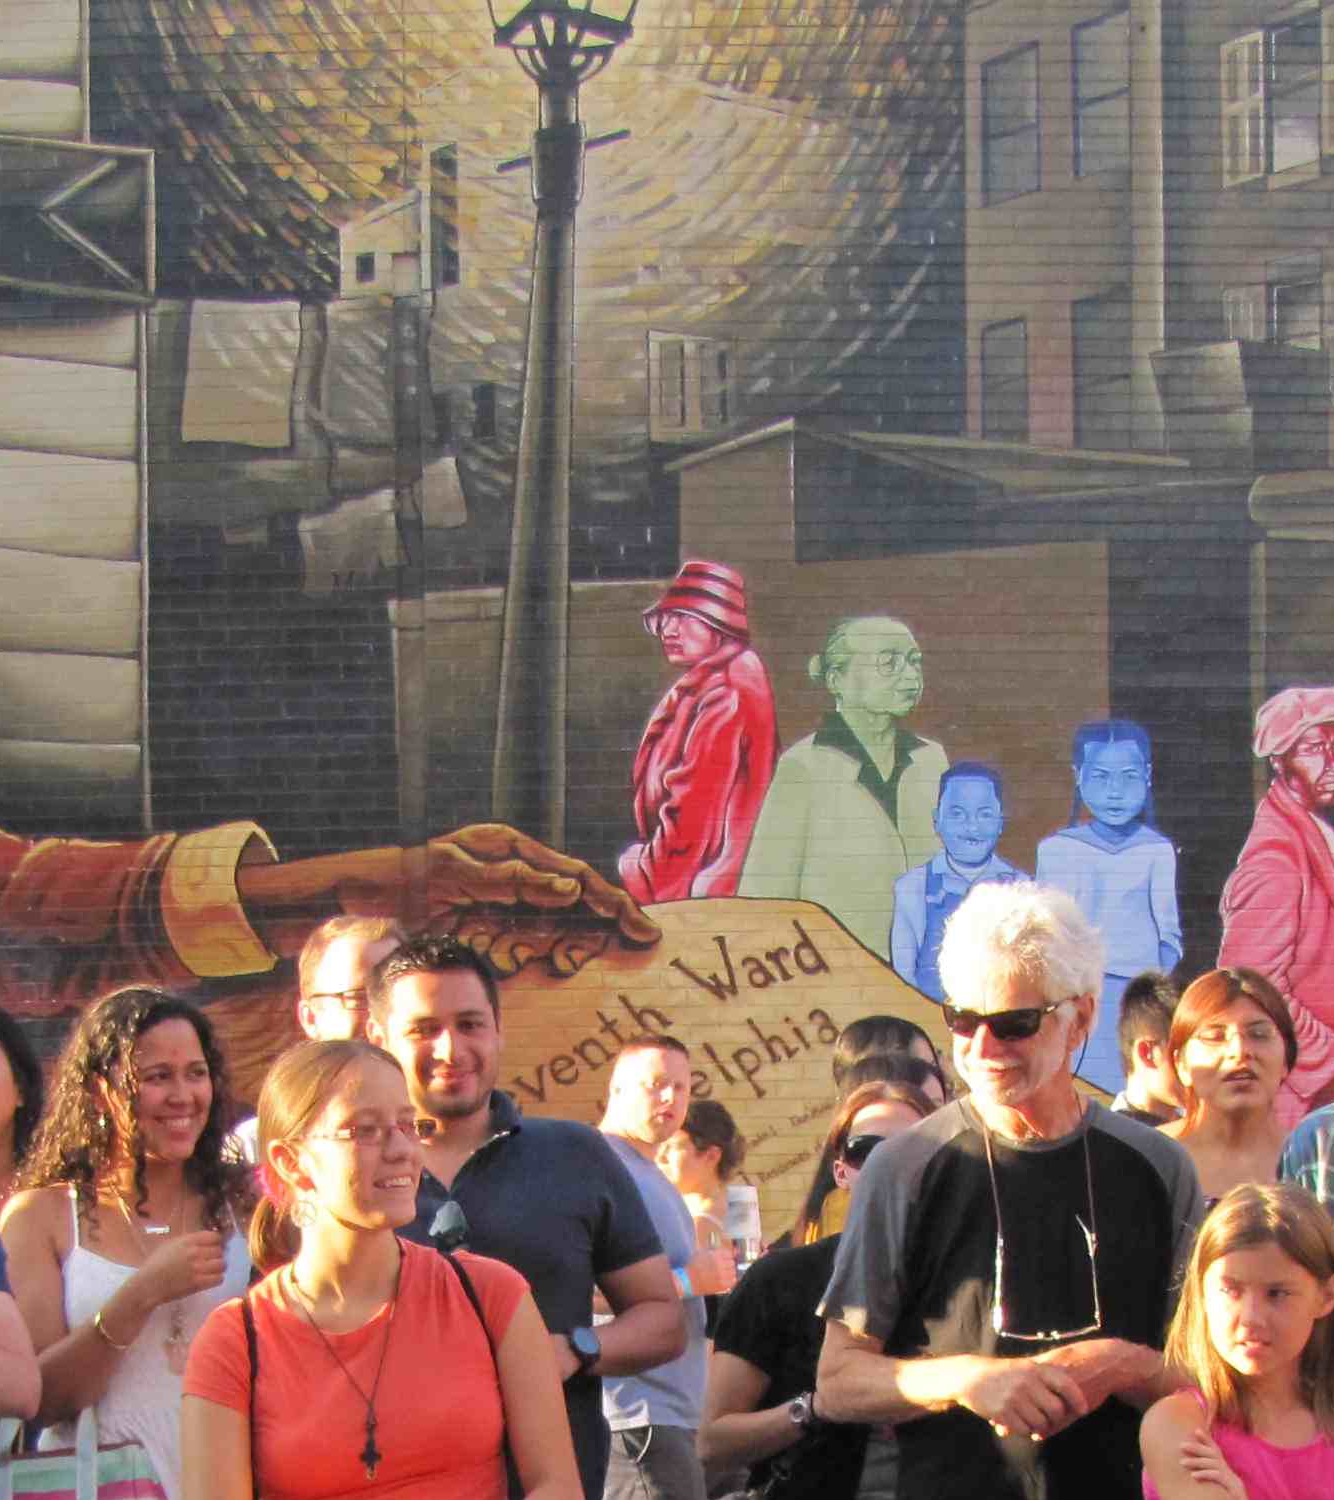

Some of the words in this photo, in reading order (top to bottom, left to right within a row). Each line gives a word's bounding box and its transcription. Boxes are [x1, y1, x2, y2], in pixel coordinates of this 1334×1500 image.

[507, 993, 675, 1103] venth
[670, 919, 830, 1001] Ward
[689, 1007, 842, 1098] elphia
